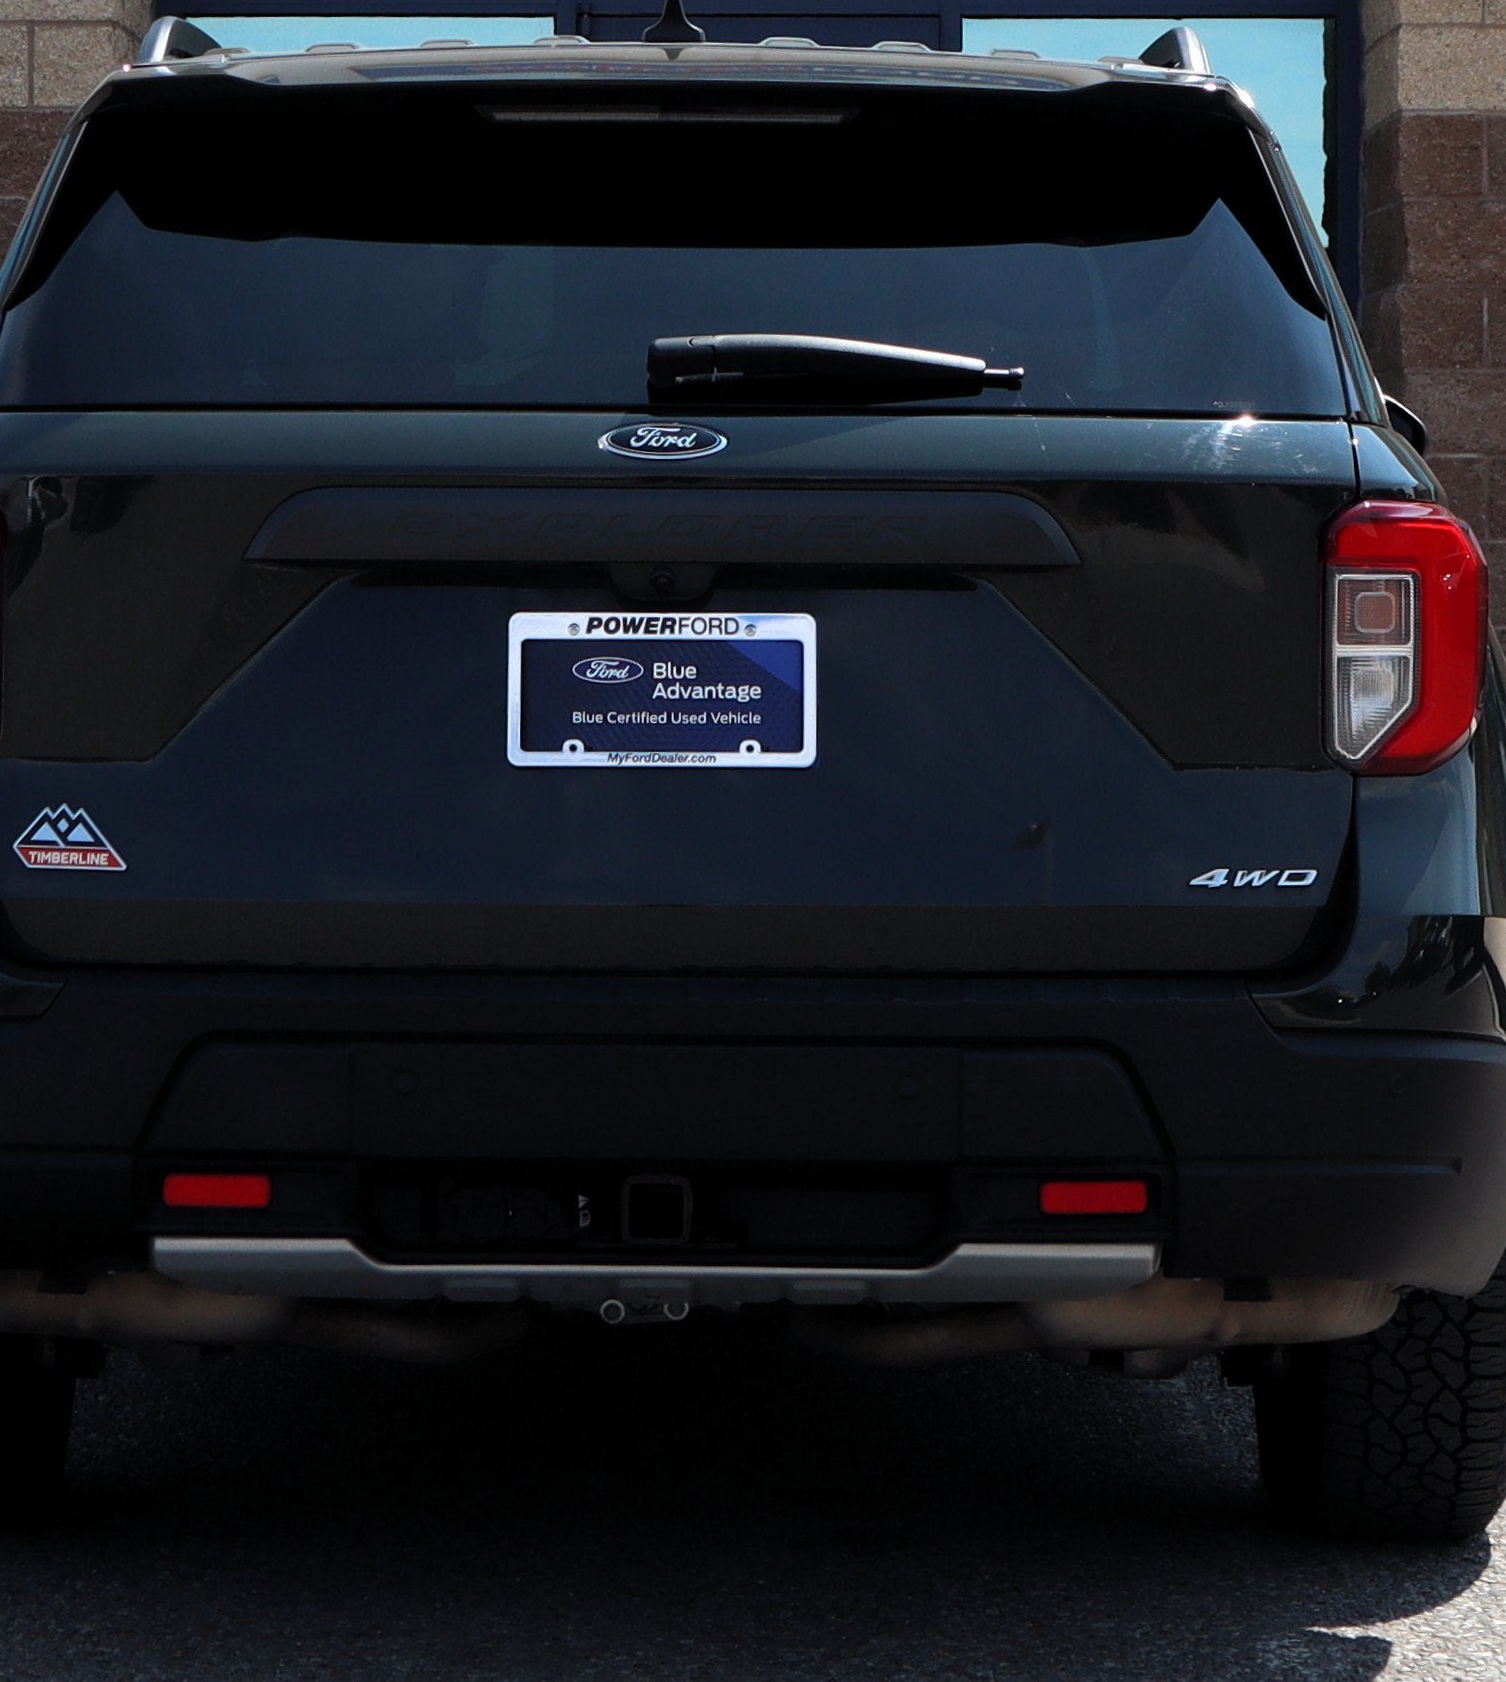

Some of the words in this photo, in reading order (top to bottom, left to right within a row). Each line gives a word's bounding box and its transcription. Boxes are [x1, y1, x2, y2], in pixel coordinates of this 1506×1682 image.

[630, 427, 698, 448] Ford
[585, 661, 630, 679] Ford
[652, 662, 697, 679] Blue
[652, 683, 762, 702] Advantage
[572, 711, 604, 724] Blue
[607, 711, 667, 724] Certified
[670, 712, 707, 725] Used
[710, 712, 762, 725] Vehicle
[606, 752, 717, 765] MyFordDealer.com
[28, 851, 109, 865] TIMBERLINE
[1189, 868, 1318, 888] 4WD
